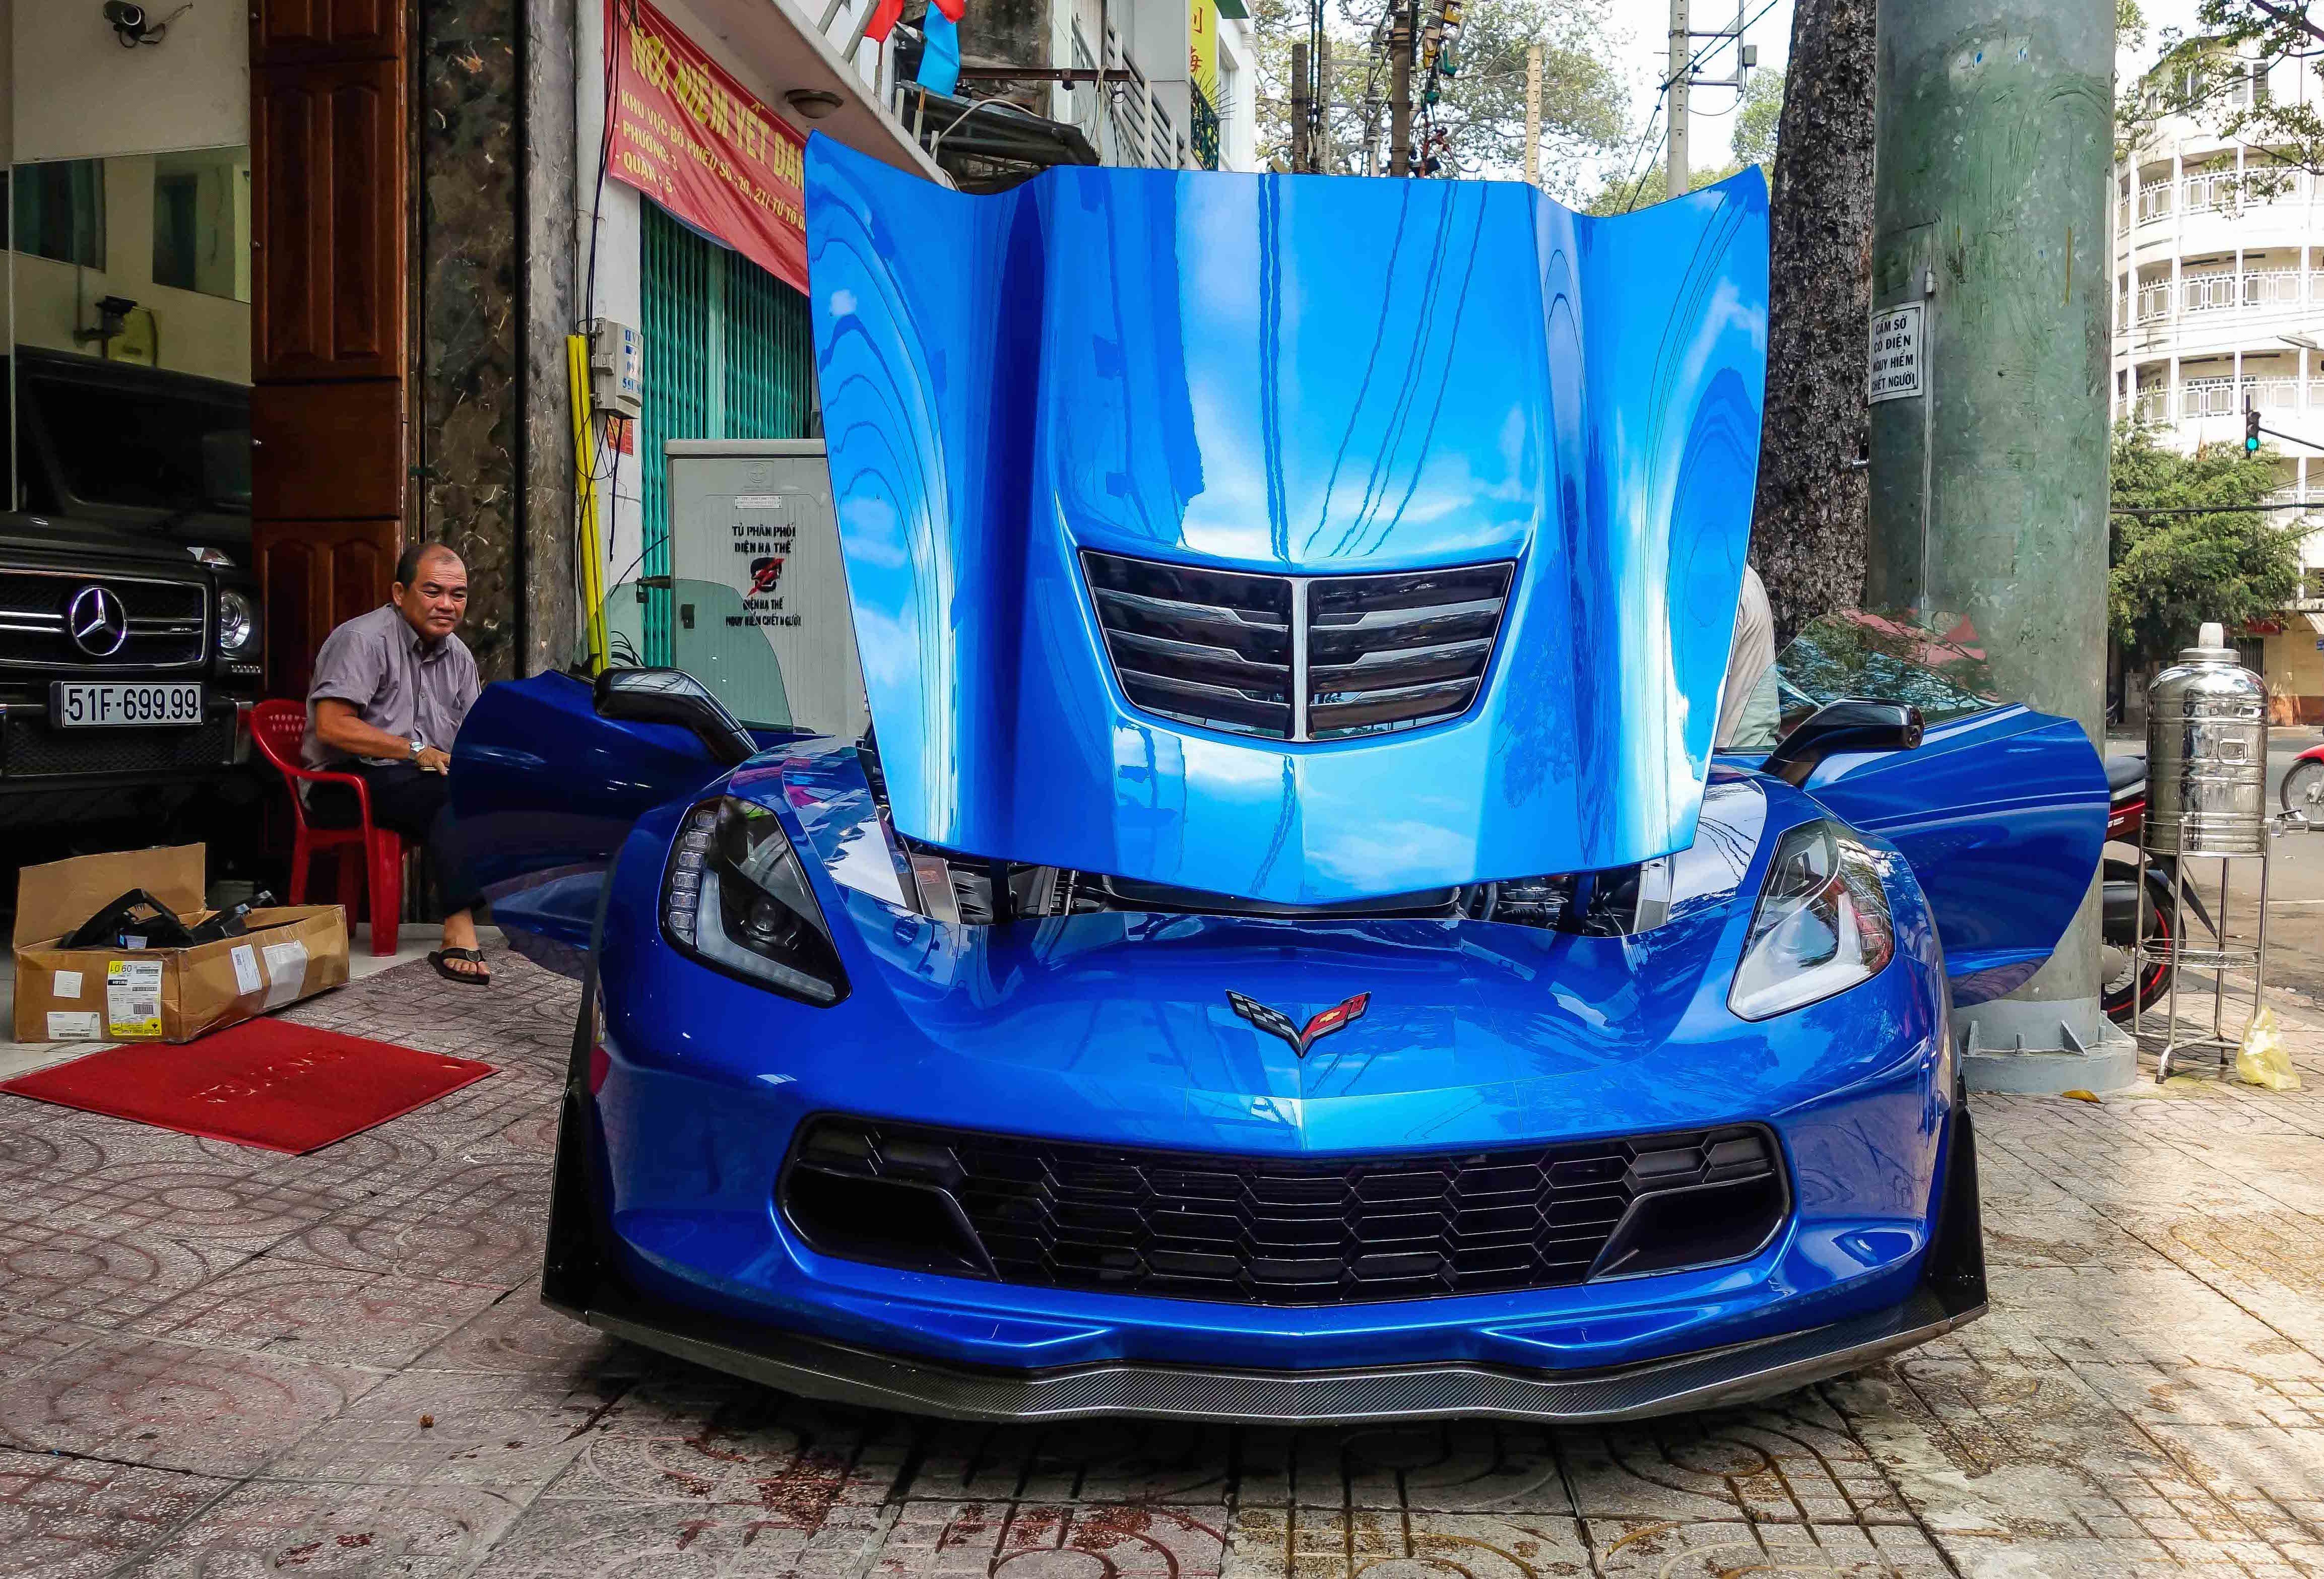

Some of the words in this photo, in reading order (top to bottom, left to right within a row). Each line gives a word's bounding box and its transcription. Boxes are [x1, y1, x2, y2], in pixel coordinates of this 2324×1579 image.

[621, 89, 644, 119] KHU
[665, 175, 673, 193] 5
[1874, 337, 1883, 353] CÓ
[1886, 333, 1911, 350] ĐIỆN
[1873, 359, 1888, 373] NGUY
[1890, 349, 1914, 368] HIỂM
[1872, 374, 1886, 392] CHẾT
[1888, 371, 1915, 388] NGƯỜI
[732, 522, 744, 537] TỦ
[758, 542, 771, 556] HẠ
[774, 539, 794, 553] THẾ
[770, 596, 785, 610] THẾ
[68, 688, 197, 721] 51F-699.99
